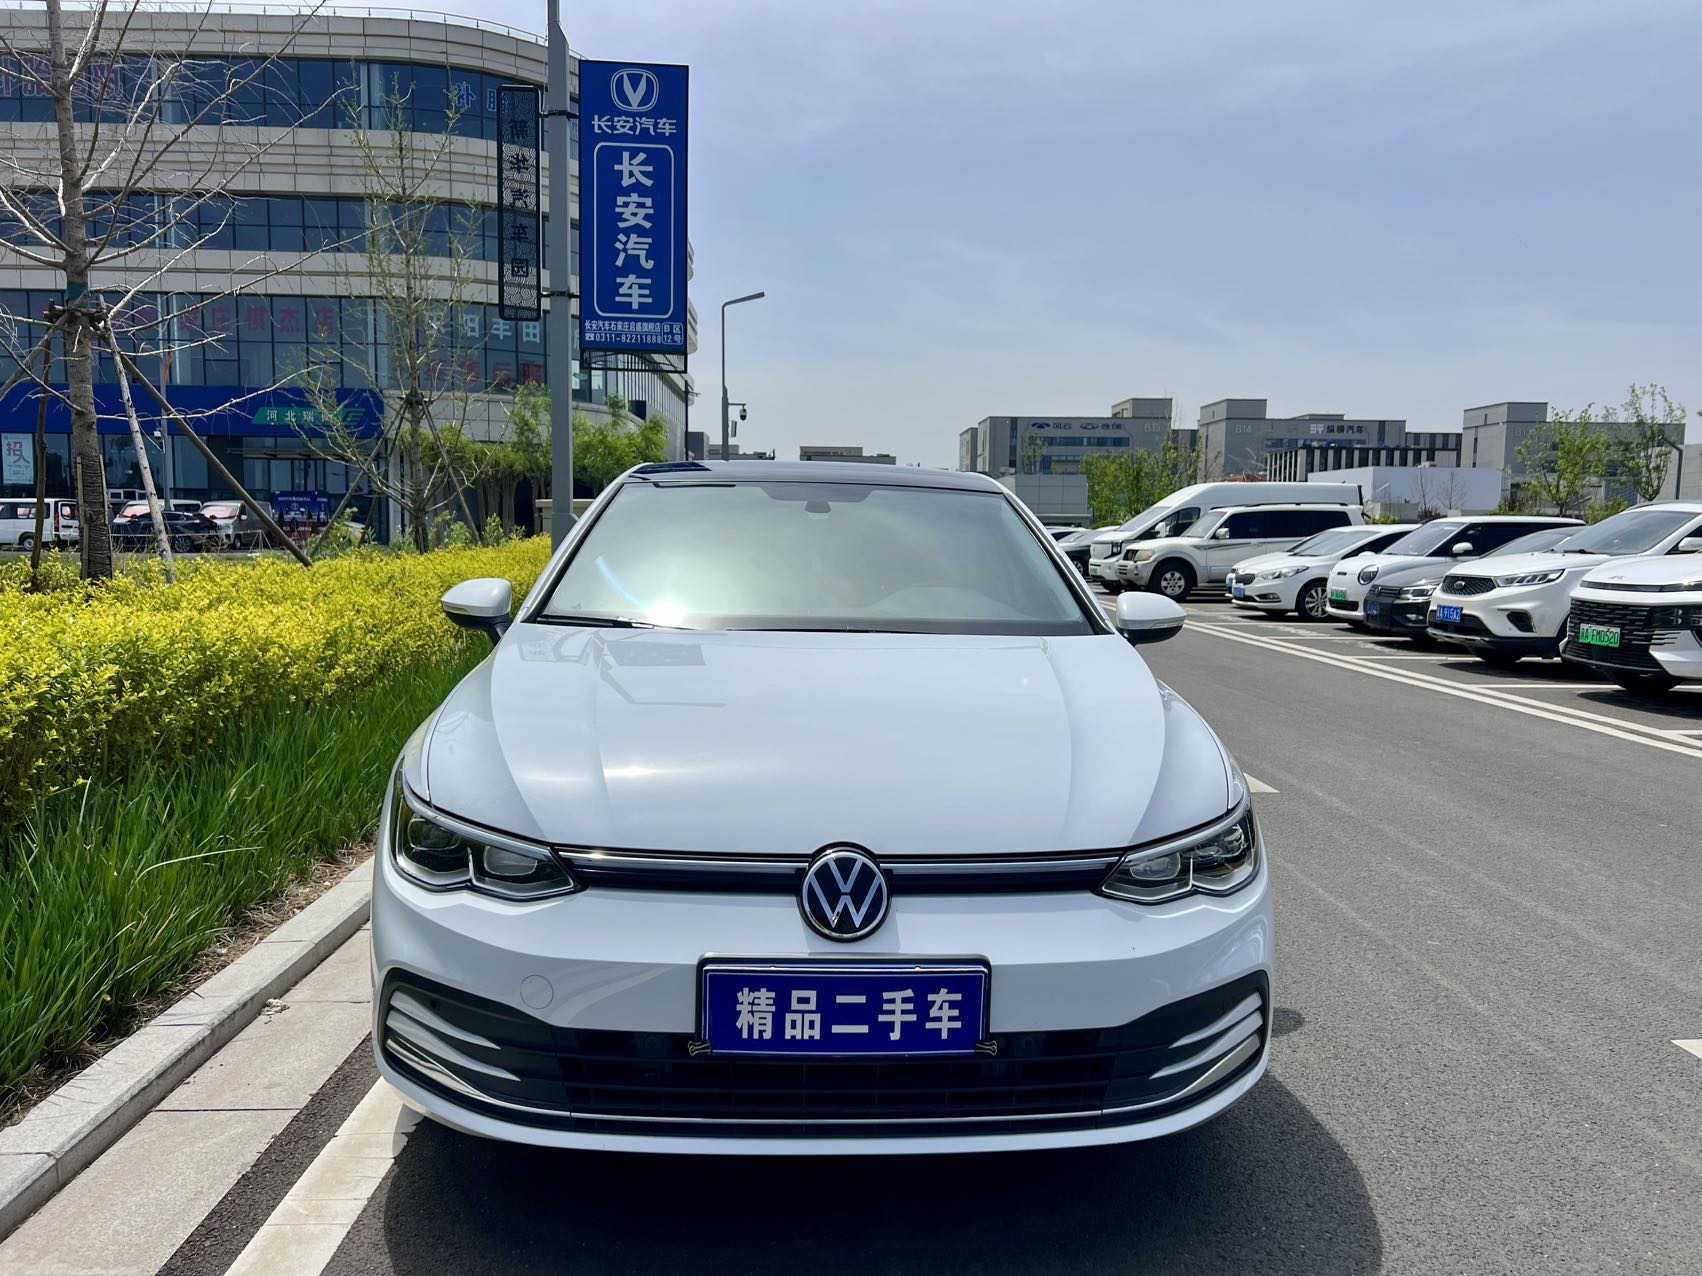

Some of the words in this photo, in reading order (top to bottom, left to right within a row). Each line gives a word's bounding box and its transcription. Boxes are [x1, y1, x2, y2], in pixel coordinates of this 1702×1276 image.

[592, 115, 677, 136] 长安汽车
[614, 151, 654, 310] 长安汽车
[595, 333, 662, 343] 0311-82211888
[736, 987, 963, 1041] 精品二手车
